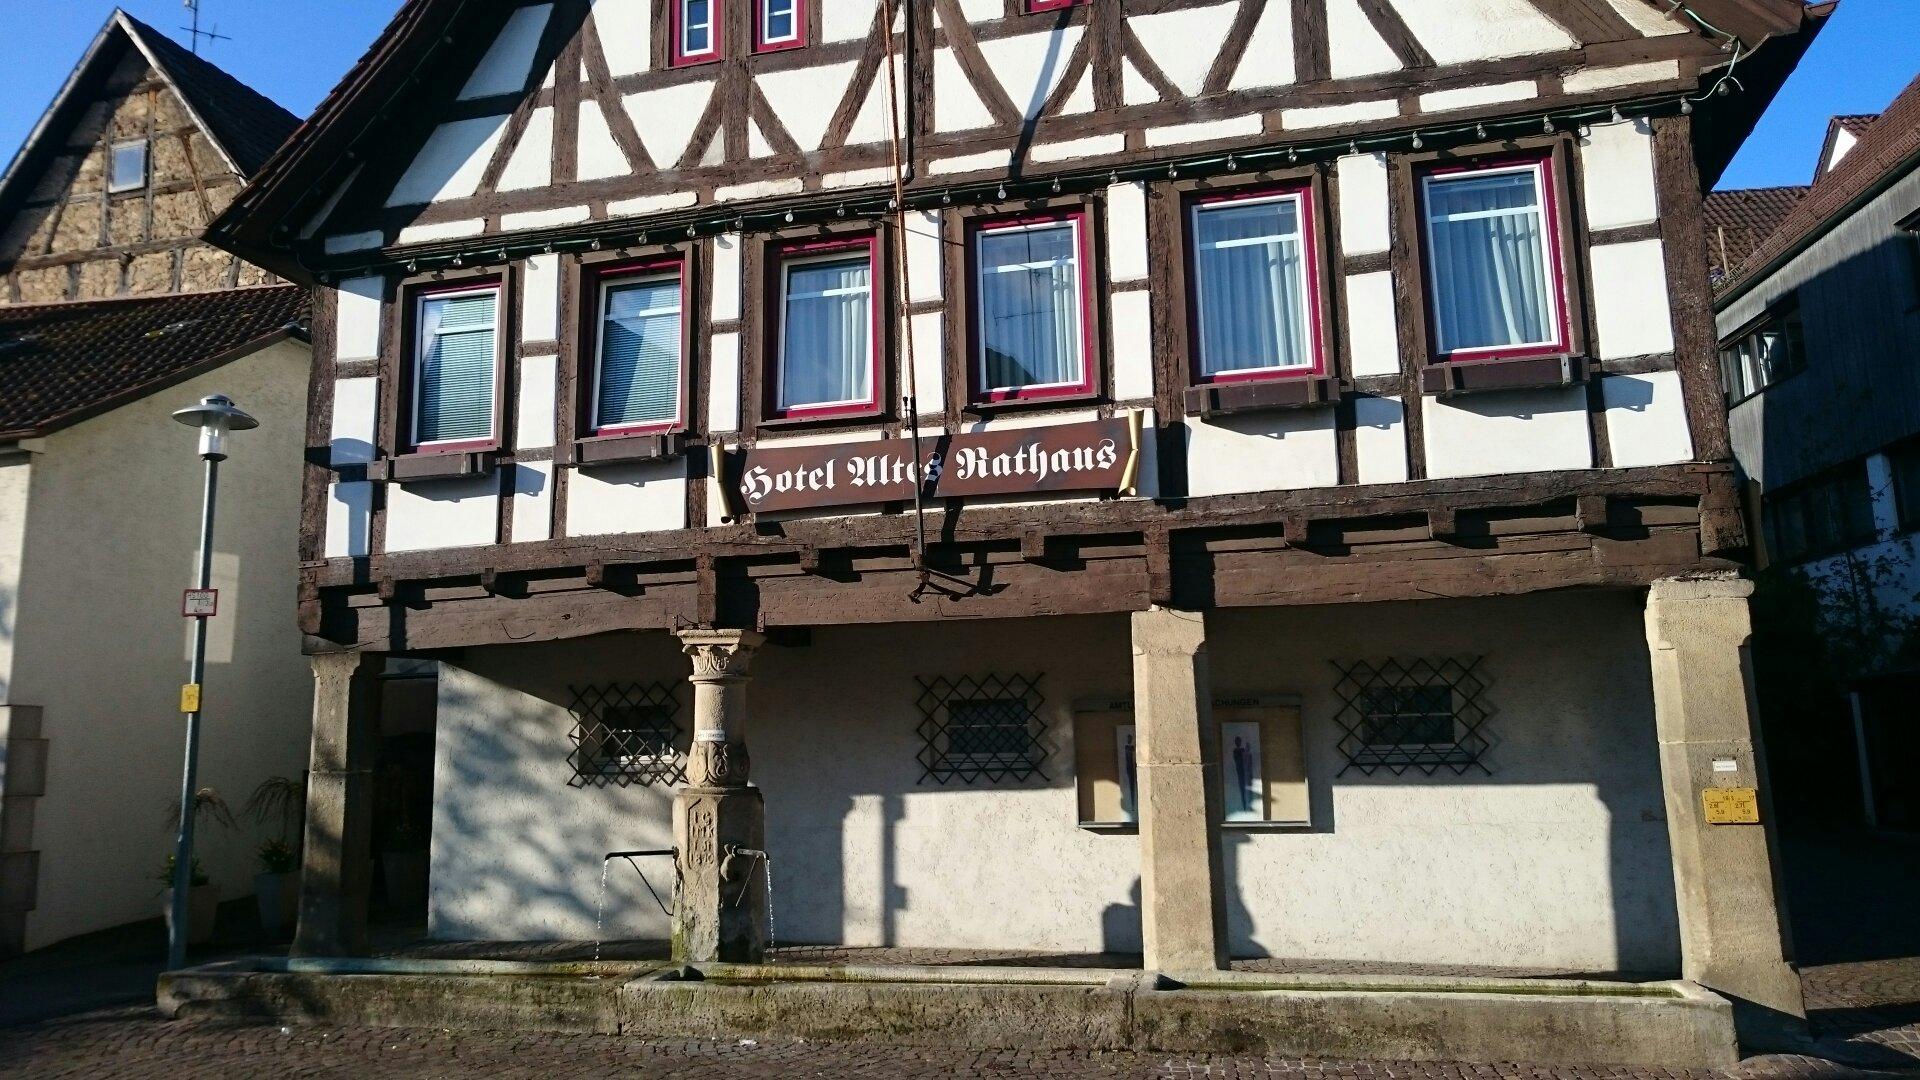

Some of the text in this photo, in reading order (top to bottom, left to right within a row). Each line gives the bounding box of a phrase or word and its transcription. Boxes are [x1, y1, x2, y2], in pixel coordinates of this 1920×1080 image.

[741, 439, 1117, 504] Hotel Altes Rathaus
